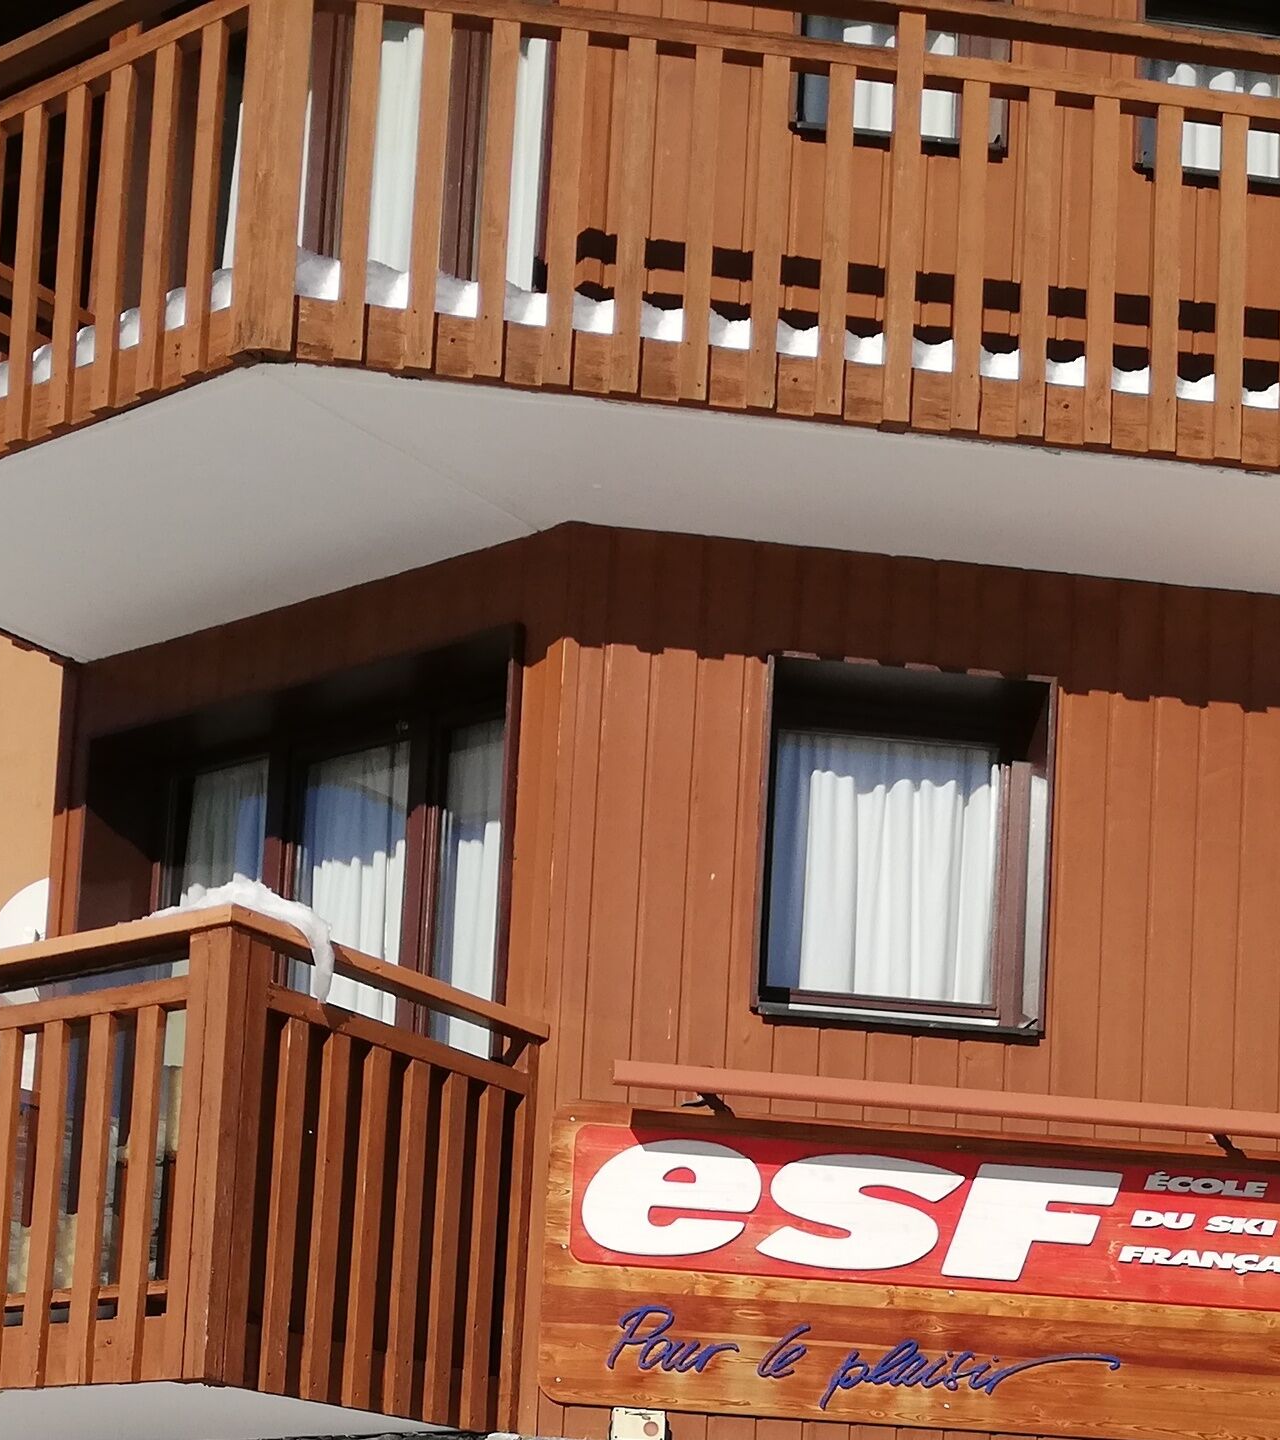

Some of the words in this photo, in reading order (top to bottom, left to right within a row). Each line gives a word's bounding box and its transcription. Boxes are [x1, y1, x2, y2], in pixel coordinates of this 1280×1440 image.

[1143, 1170, 1270, 1199] ÉCOLE
[1130, 1209, 1194, 1232] DU
[1204, 1214, 1280, 1237] SKI
[606, 1304, 740, 1373] Pour
[756, 1324, 812, 1380] le
[819, 1338, 1121, 1409] plaisir
